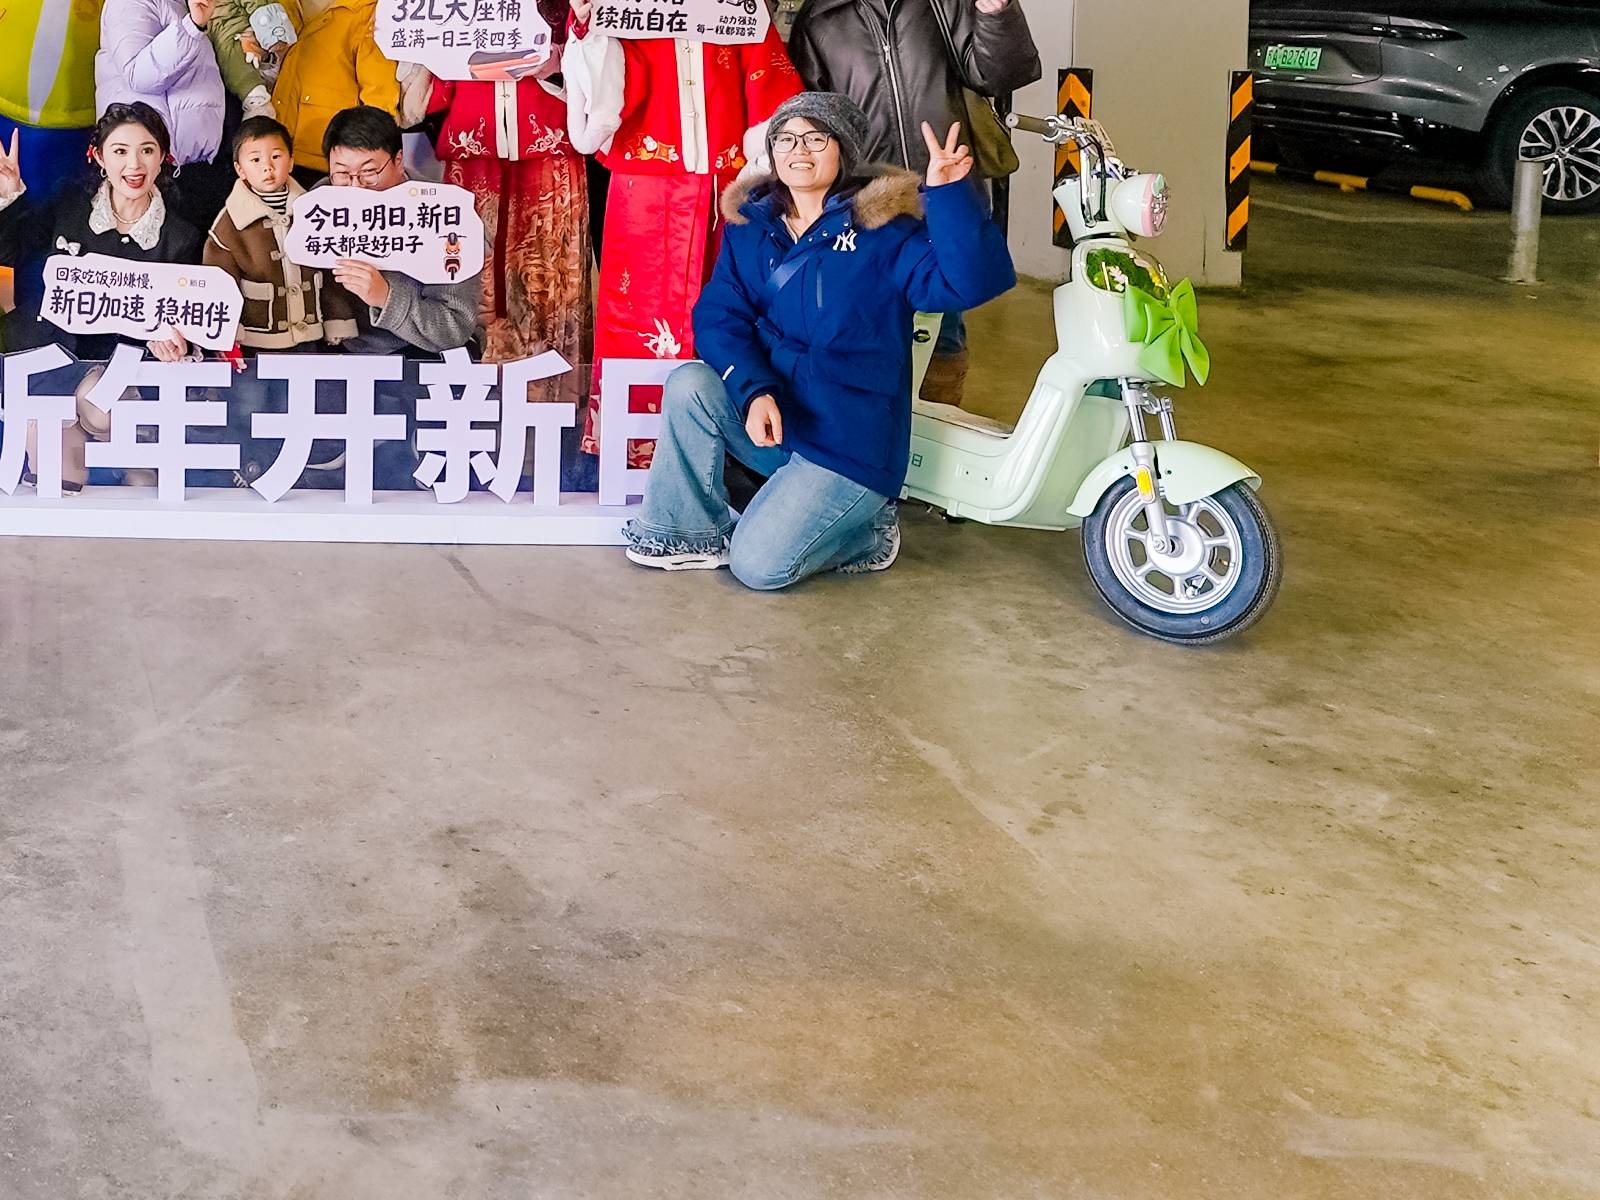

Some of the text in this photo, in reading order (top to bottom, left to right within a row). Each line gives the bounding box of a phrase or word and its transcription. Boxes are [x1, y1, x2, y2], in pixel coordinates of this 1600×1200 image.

[595, 6, 688, 32] 续航自在
[697, 23, 756, 37] 每一程都踏实
[719, 15, 757, 26] 动力强劲
[391, 28, 523, 49] 盛满一日三餐四季
[305, 203, 461, 233] 今日，明日，新日
[305, 234, 424, 258] 每天都是好日子
[56, 267, 153, 290] 回家吃饭别嫌慢，
